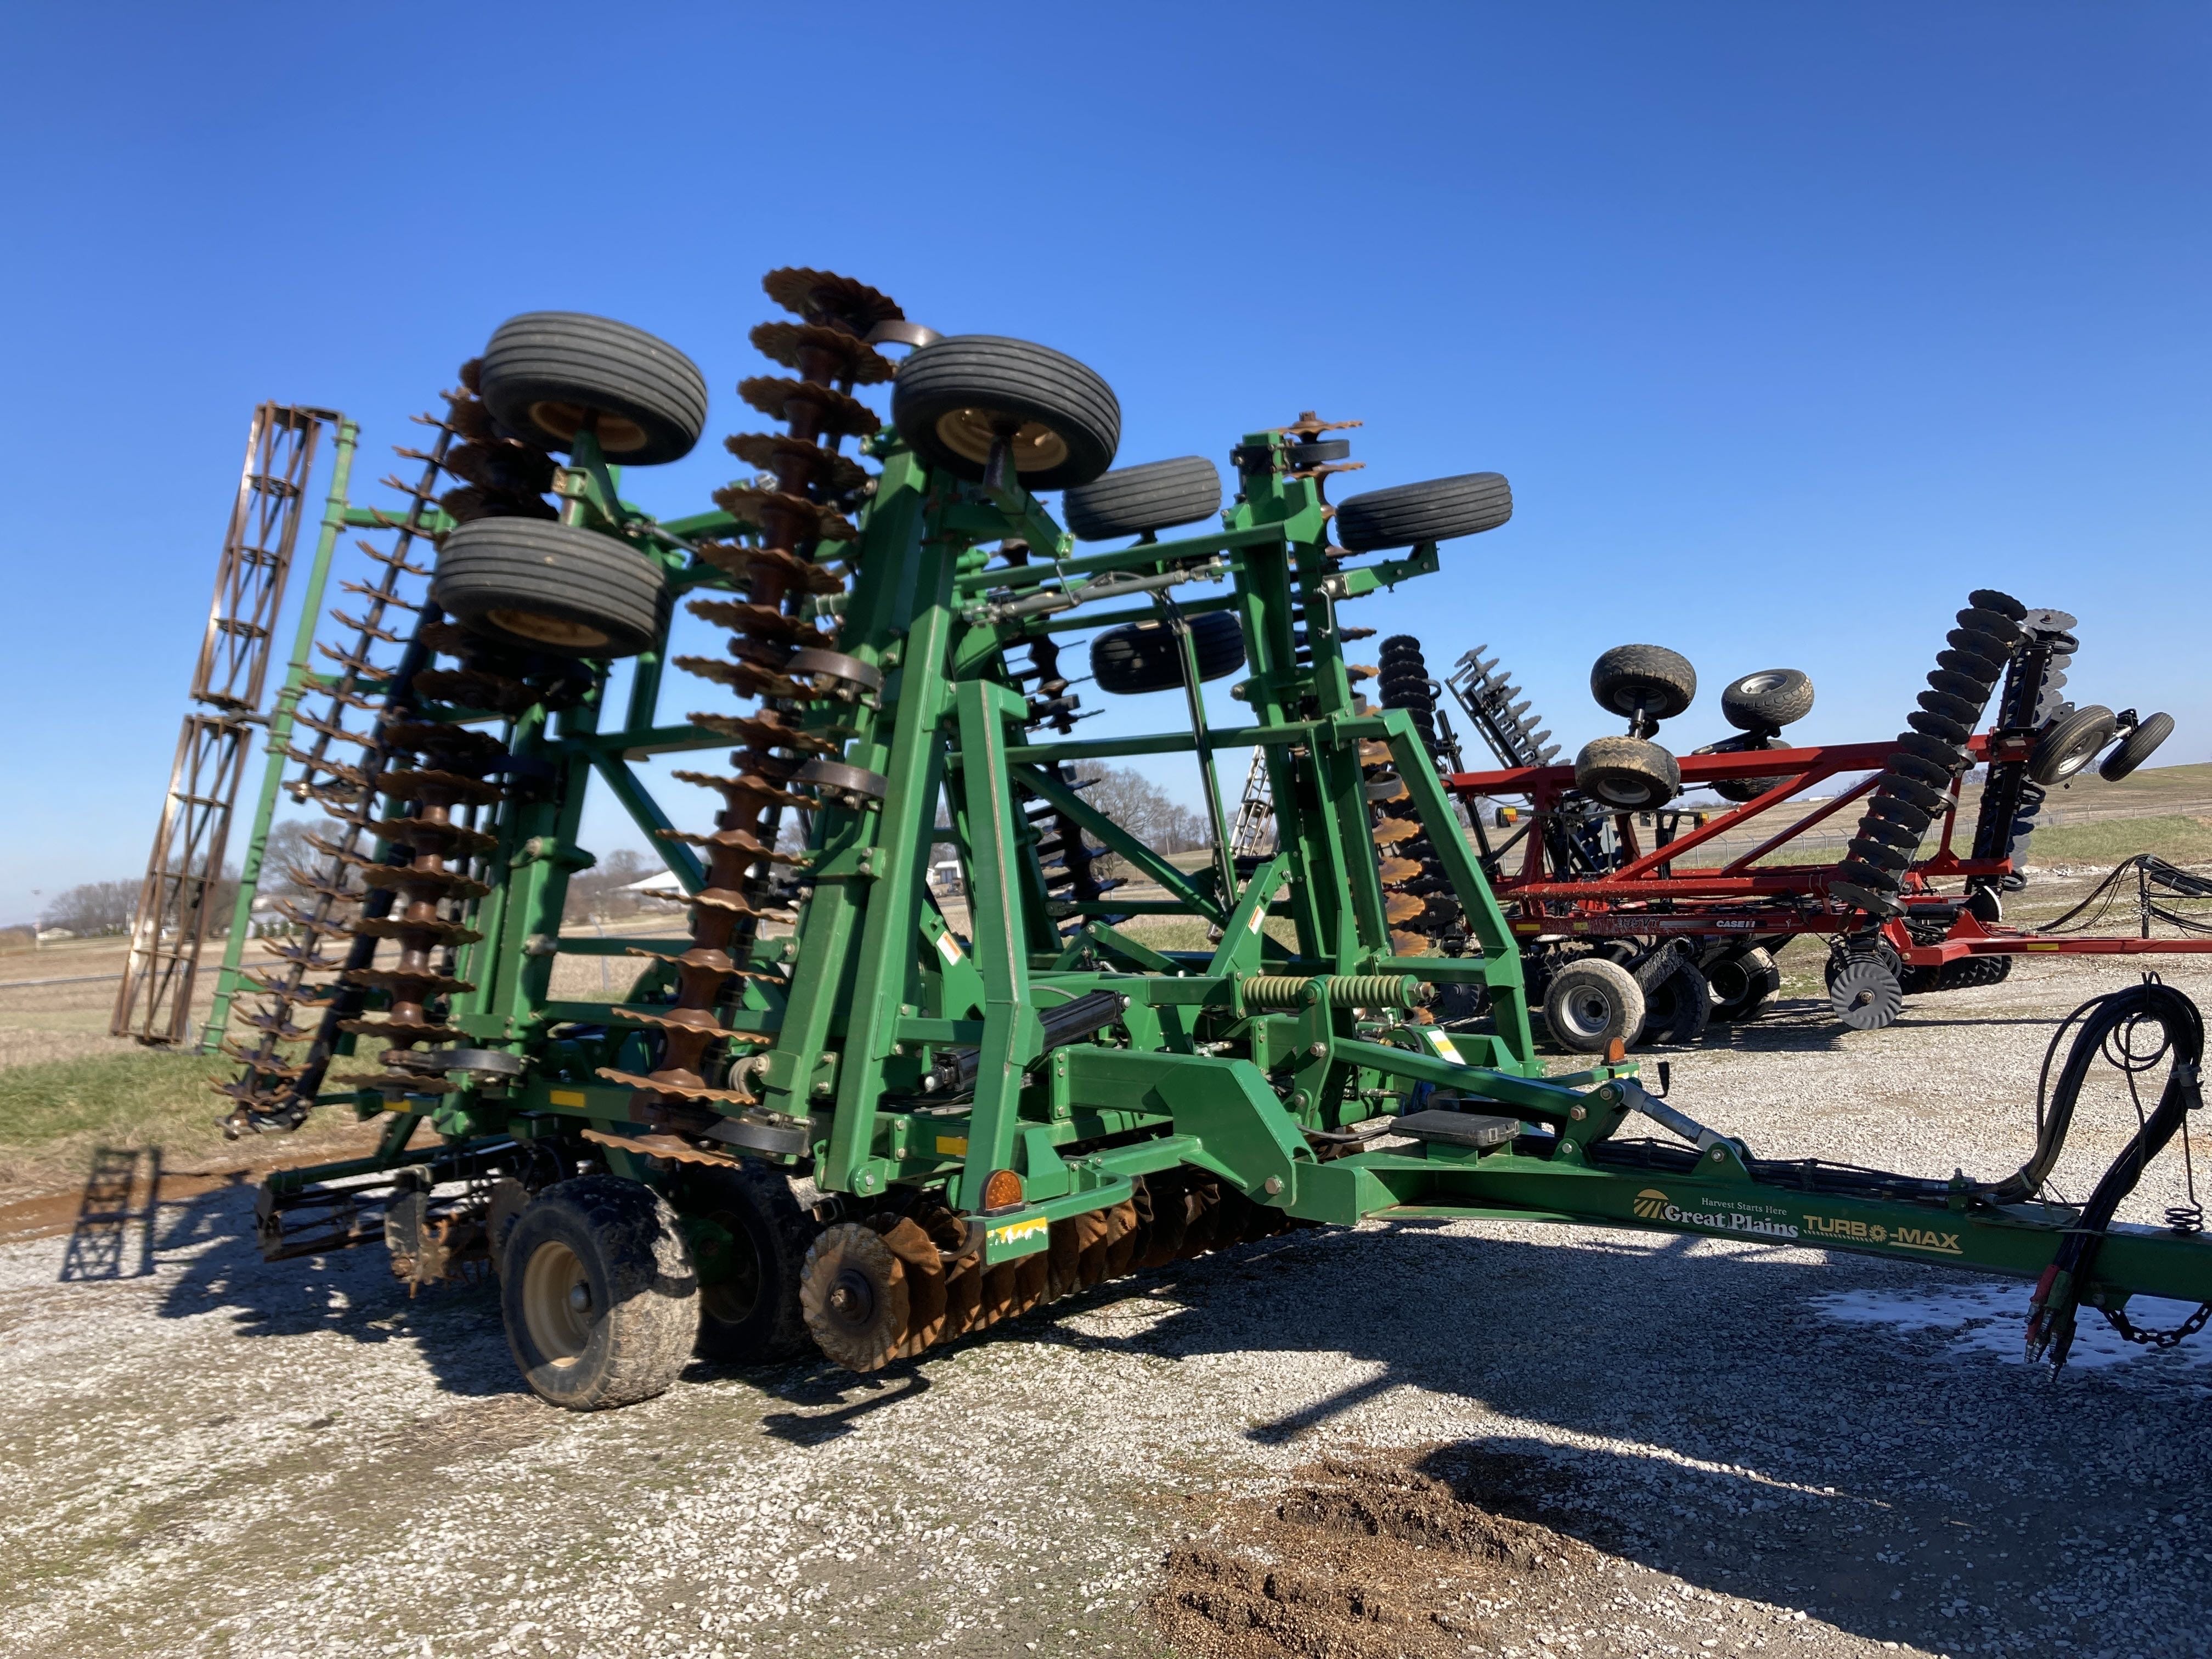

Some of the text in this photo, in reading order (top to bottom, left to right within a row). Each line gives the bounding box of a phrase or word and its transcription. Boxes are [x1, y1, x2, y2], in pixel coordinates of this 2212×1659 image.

[1702, 1198, 1787, 1216] Harvest Starts Here
[1664, 1205, 1799, 1238] Great Plains
